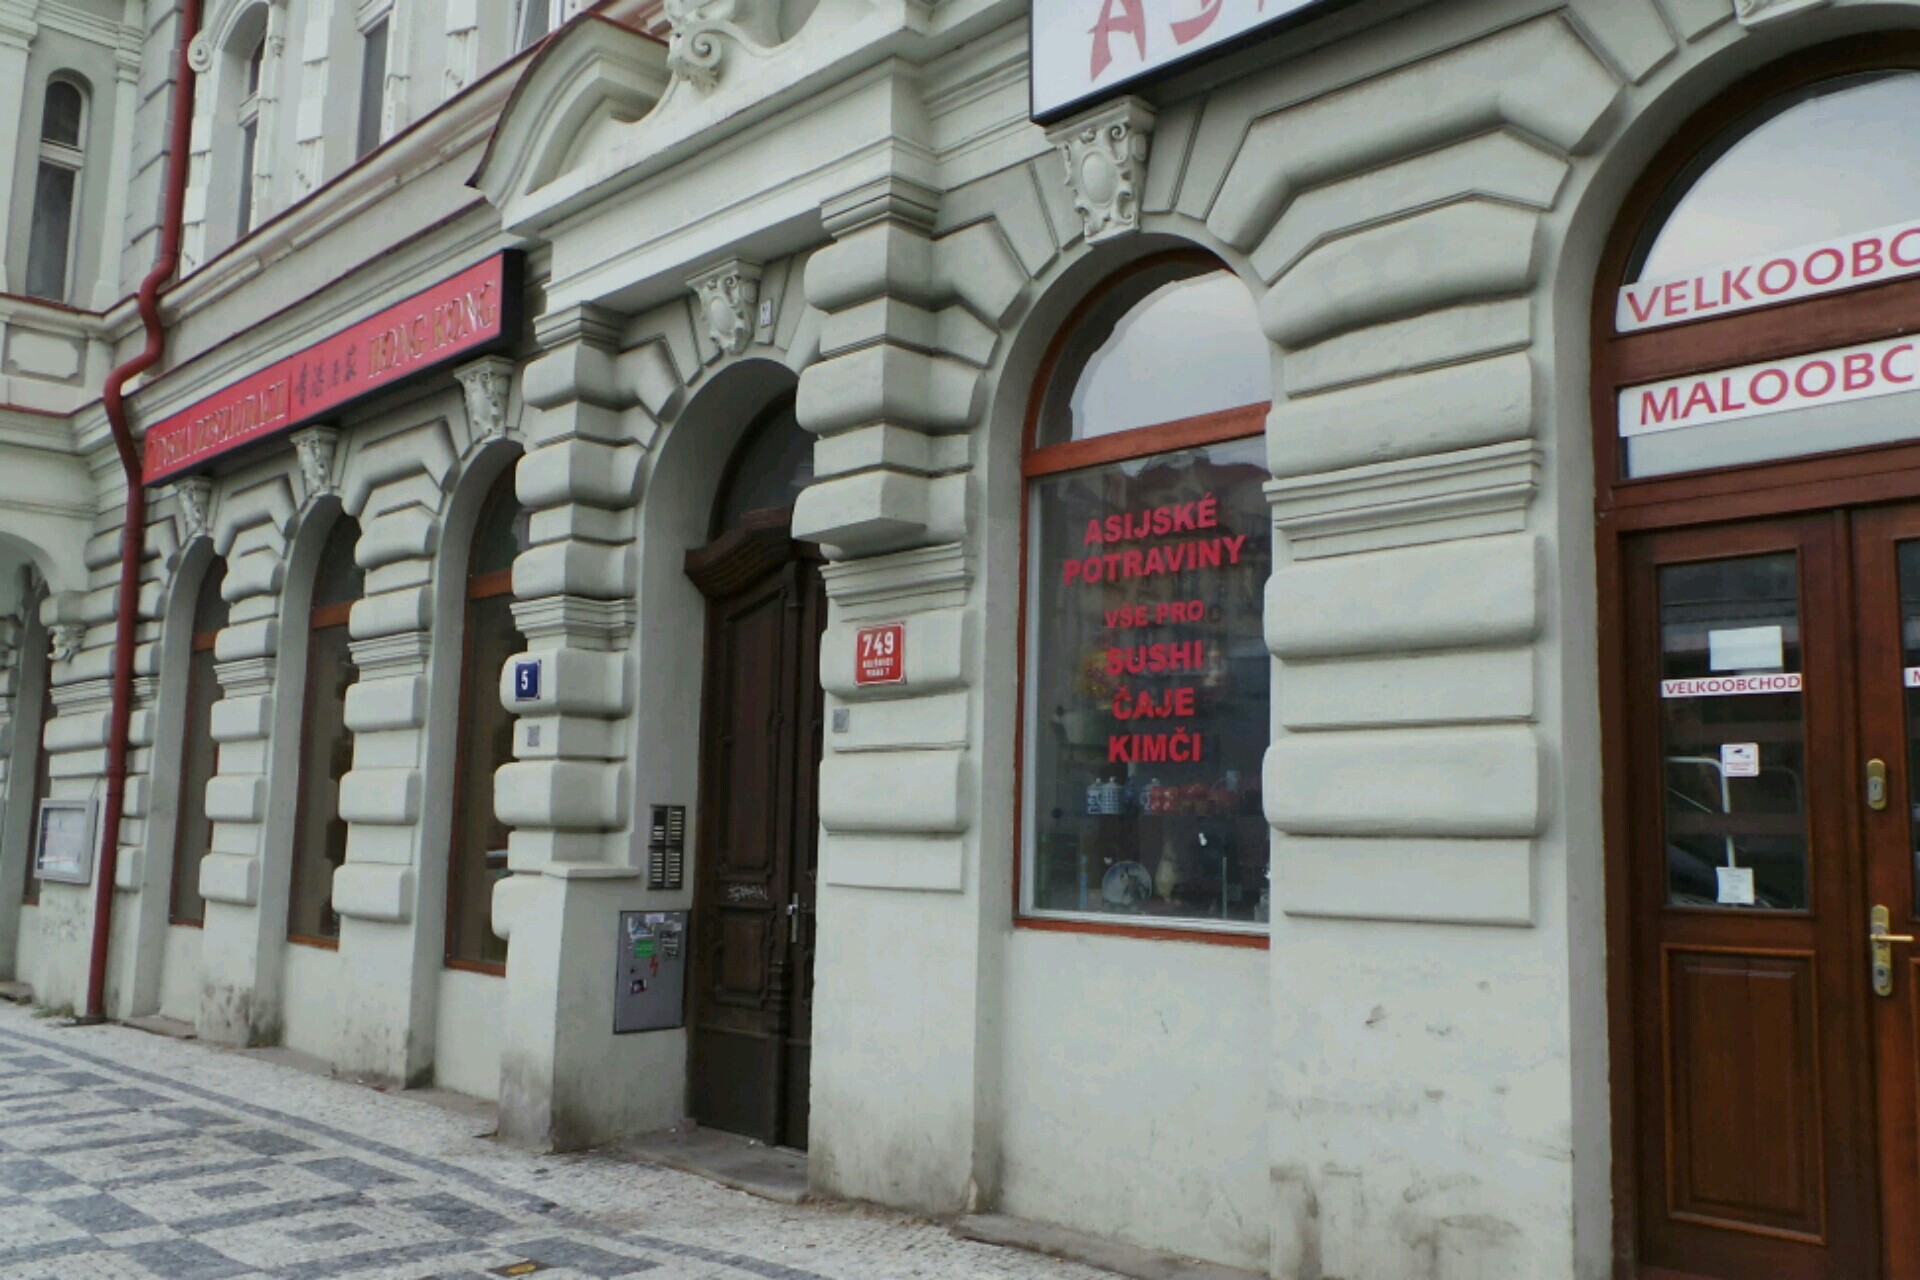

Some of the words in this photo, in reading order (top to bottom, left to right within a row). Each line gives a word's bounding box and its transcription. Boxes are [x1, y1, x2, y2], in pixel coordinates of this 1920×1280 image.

[368, 314, 427, 379] HONG
[432, 280, 496, 351] KONG
[1640, 344, 1914, 425] MALOOBC
[1083, 492, 1218, 546] ASIJSKÉ
[1063, 534, 1247, 586] POTRAVINY
[1104, 602, 1148, 629] VŠE
[1156, 600, 1205, 624] PRO
[862, 631, 894, 657] 749
[1104, 640, 1204, 676] SUSHI
[521, 669, 528, 690] 5
[1664, 675, 1801, 695] VELKOOBCHOD
[1112, 685, 1195, 720] ČAJE
[1108, 727, 1202, 763] KIMČI
